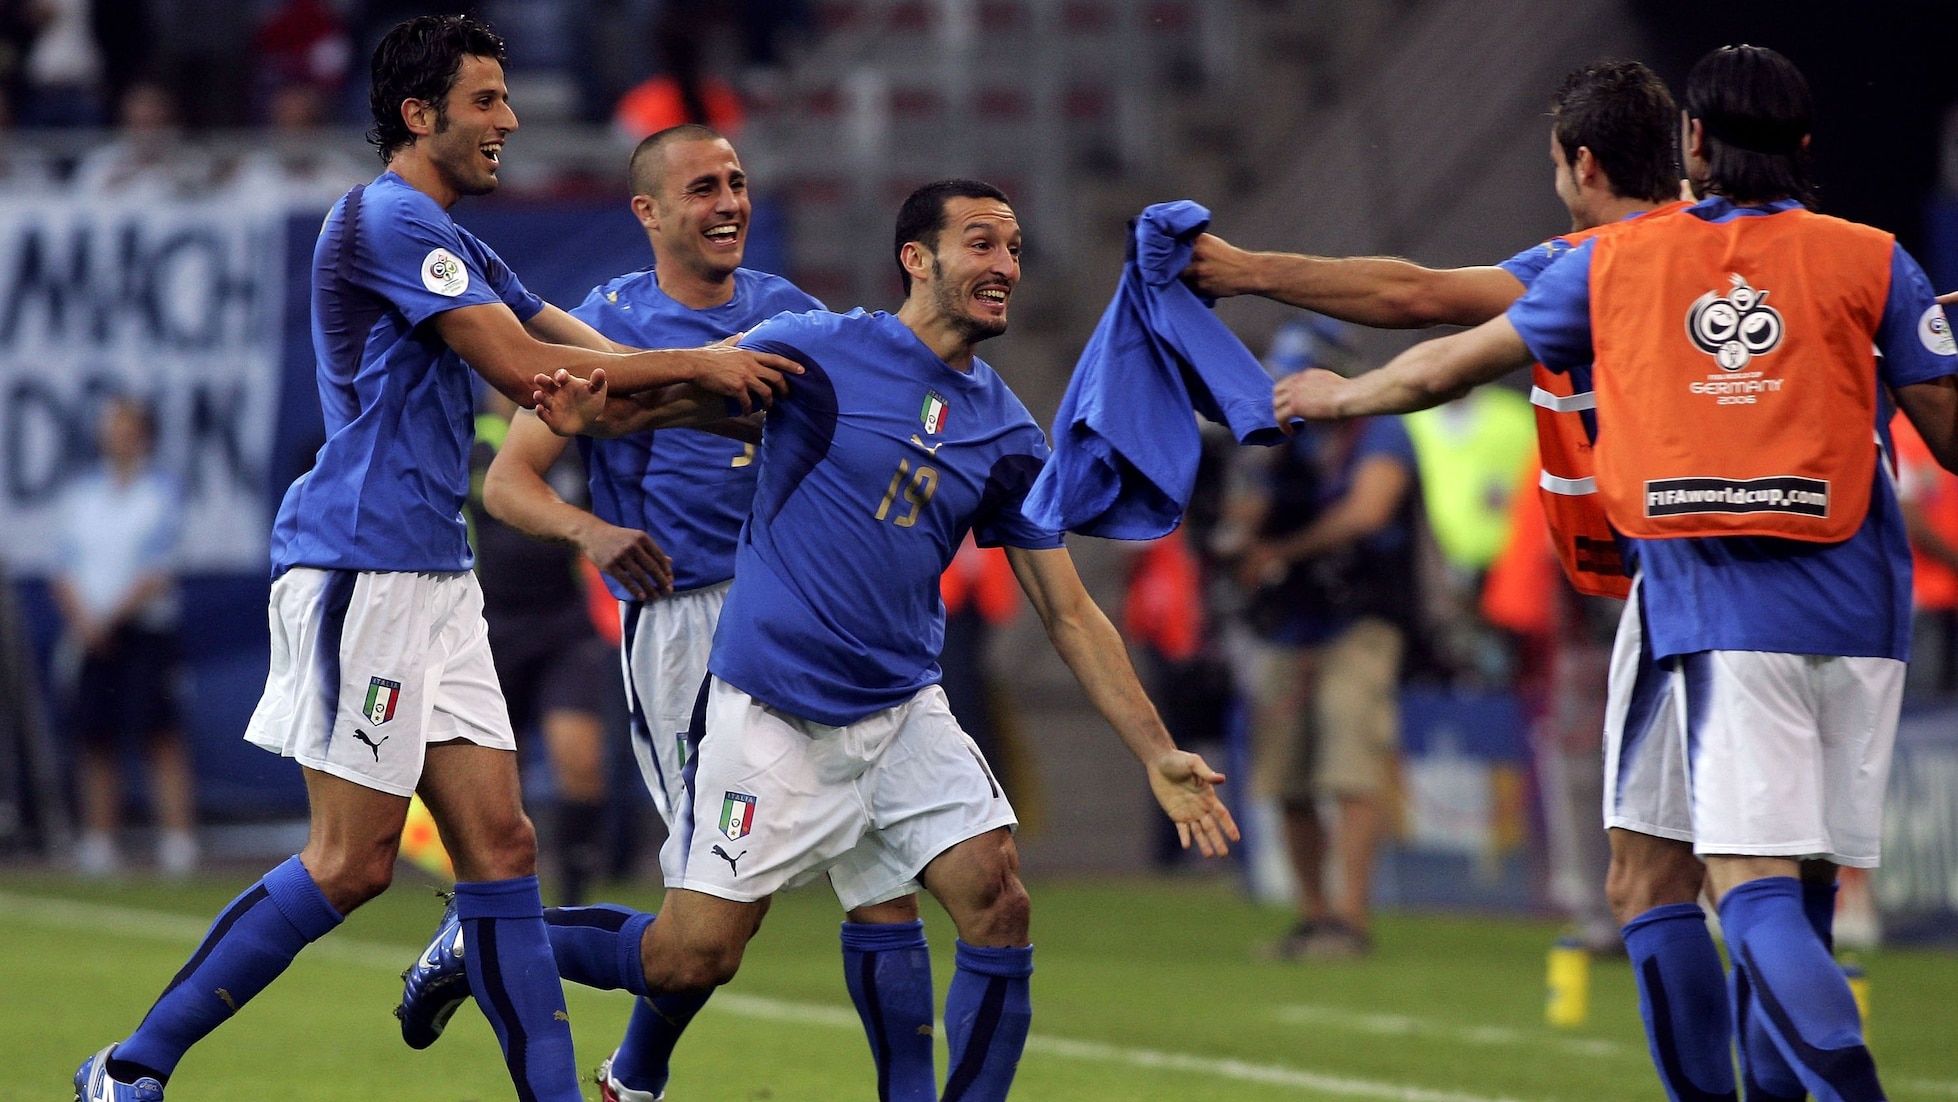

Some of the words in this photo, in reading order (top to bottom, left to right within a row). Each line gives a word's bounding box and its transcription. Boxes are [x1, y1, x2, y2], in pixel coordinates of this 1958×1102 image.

[1689, 379, 1784, 395] GERMANY
[1717, 395, 1757, 405] 2006
[875, 458, 939, 527] 19
[1648, 487, 1827, 507] FIFAworldcup.com
[727, 792, 754, 803] ITALIA
